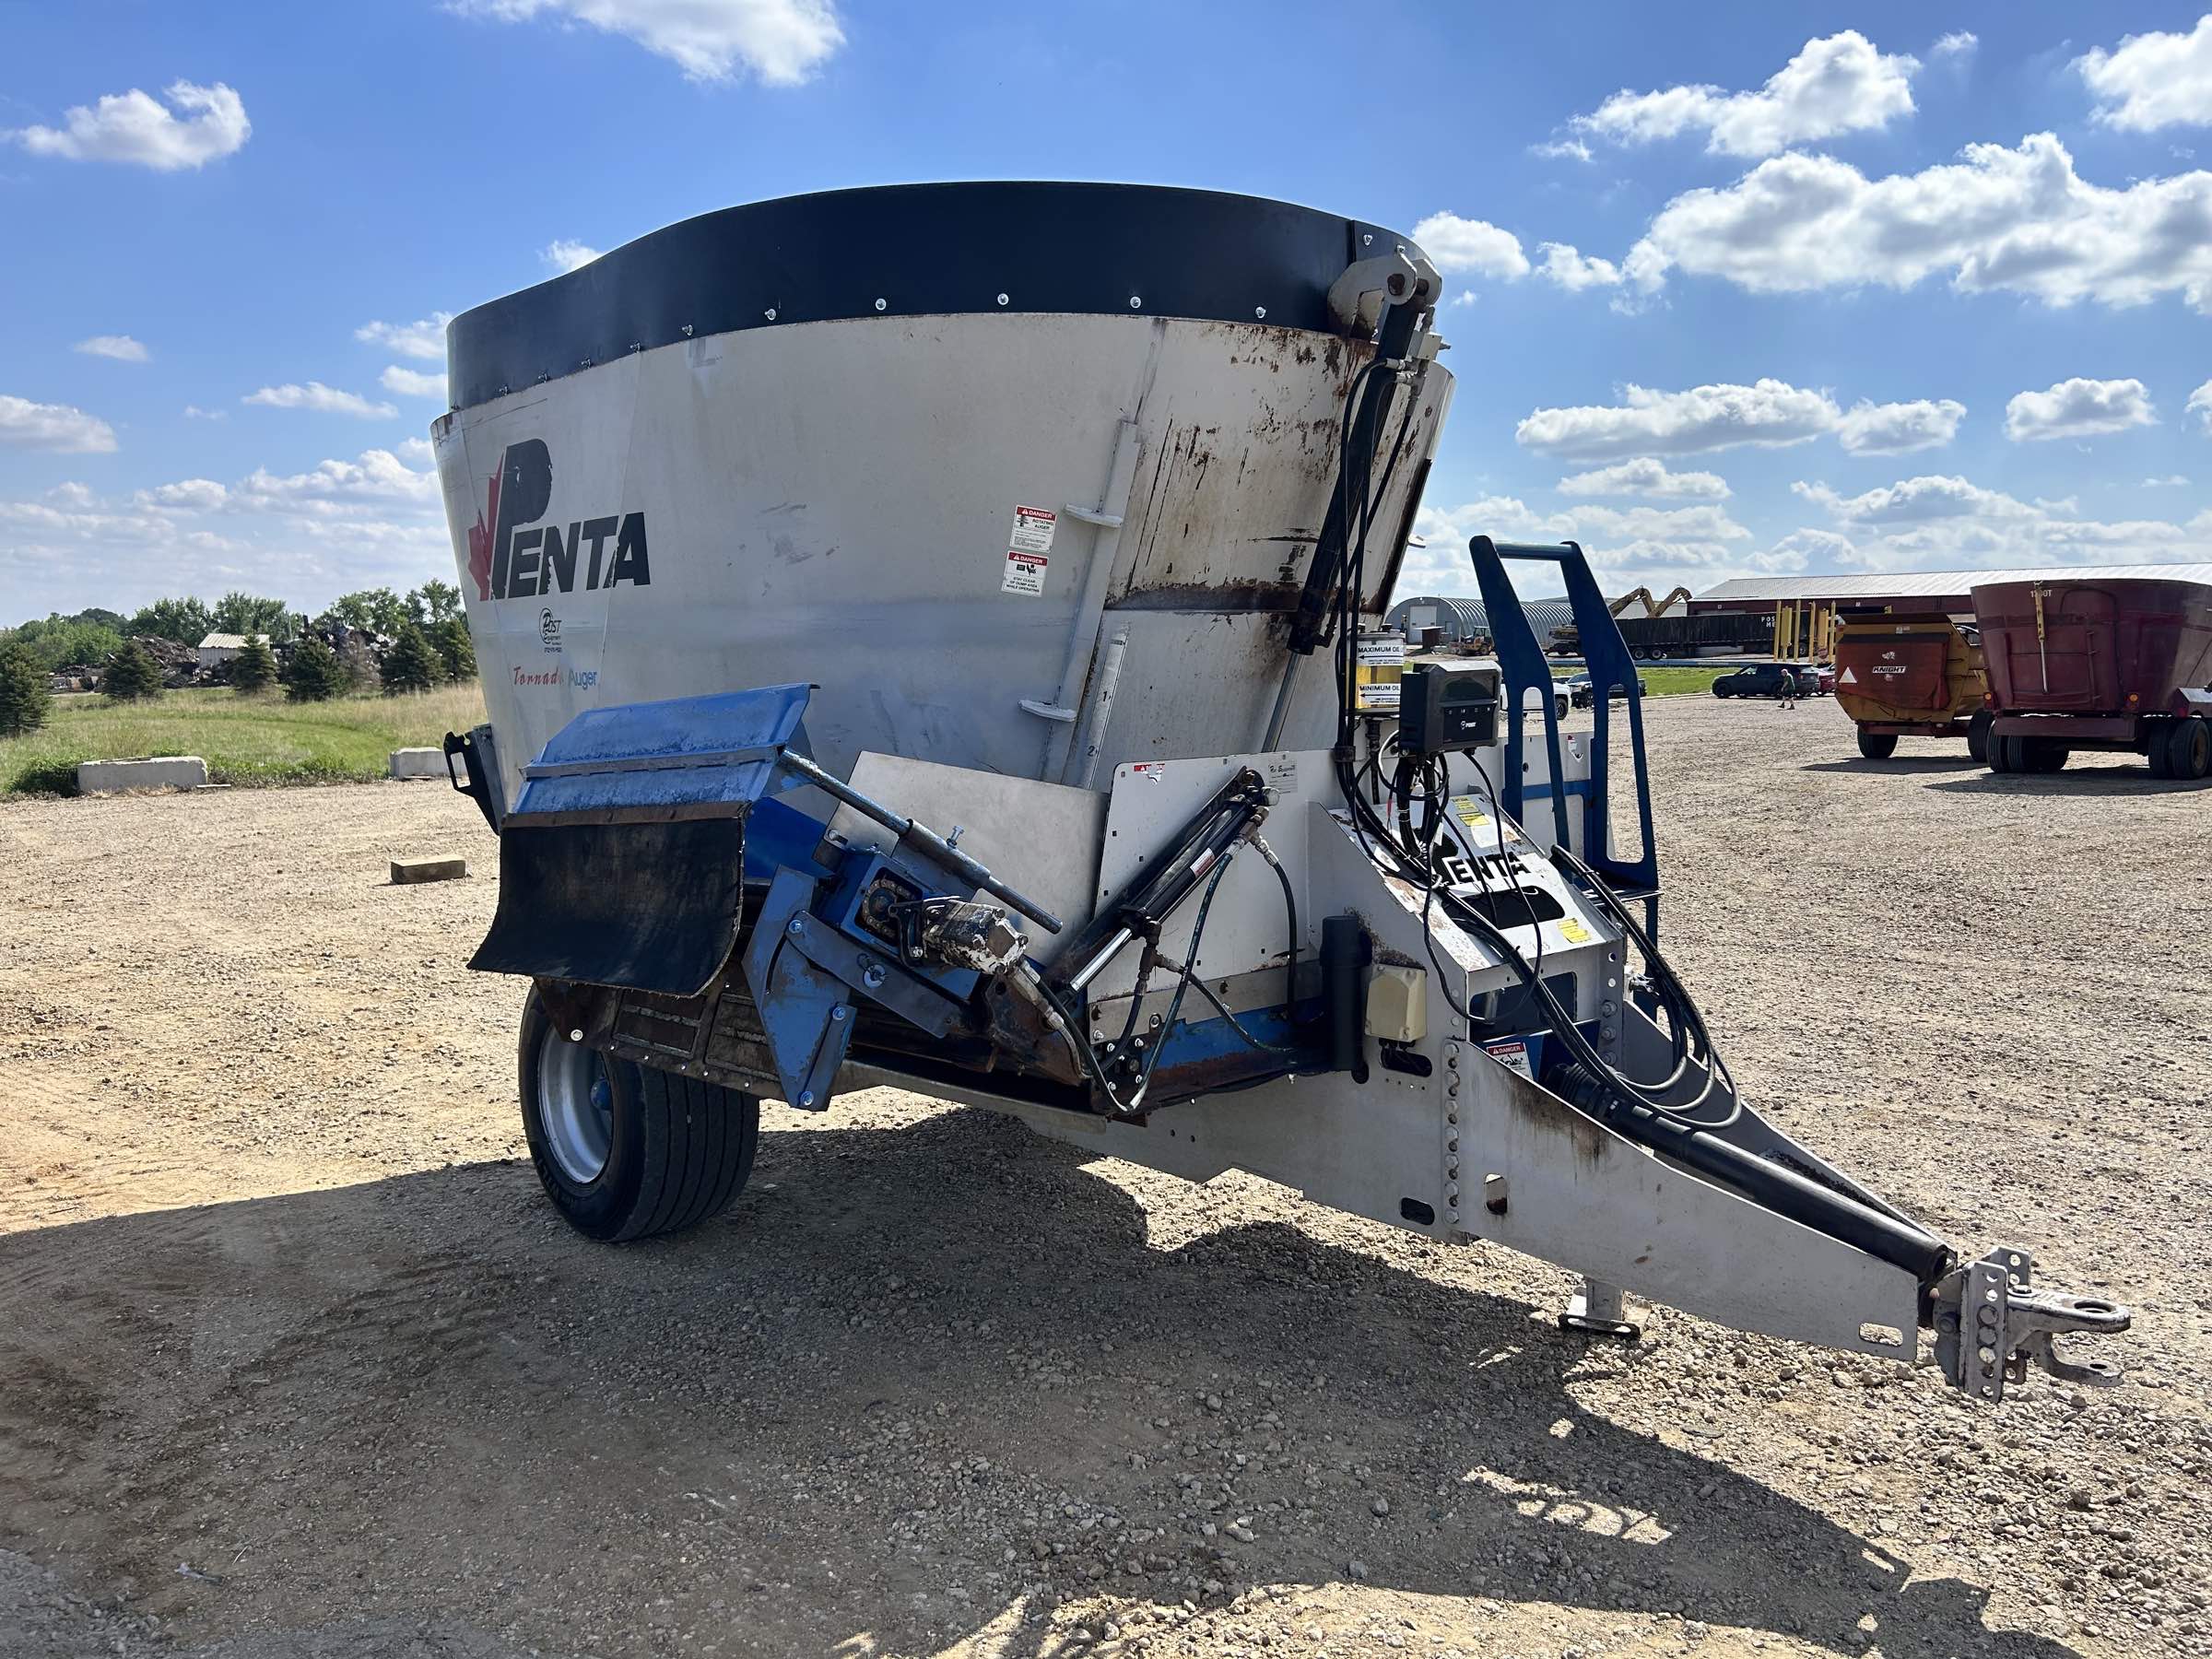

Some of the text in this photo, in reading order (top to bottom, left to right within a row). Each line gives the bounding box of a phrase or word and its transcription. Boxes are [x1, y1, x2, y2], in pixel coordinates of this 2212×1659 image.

[490, 438, 651, 601] PENTA
[1029, 510, 1053, 518] DANGER
[1019, 556, 1043, 564] DANGER
[513, 665, 598, 690] Tornad Auger
[1102, 690, 1107, 701] 1
[1087, 745, 1096, 757] 2
[1498, 1045, 1522, 1053] DANGER
